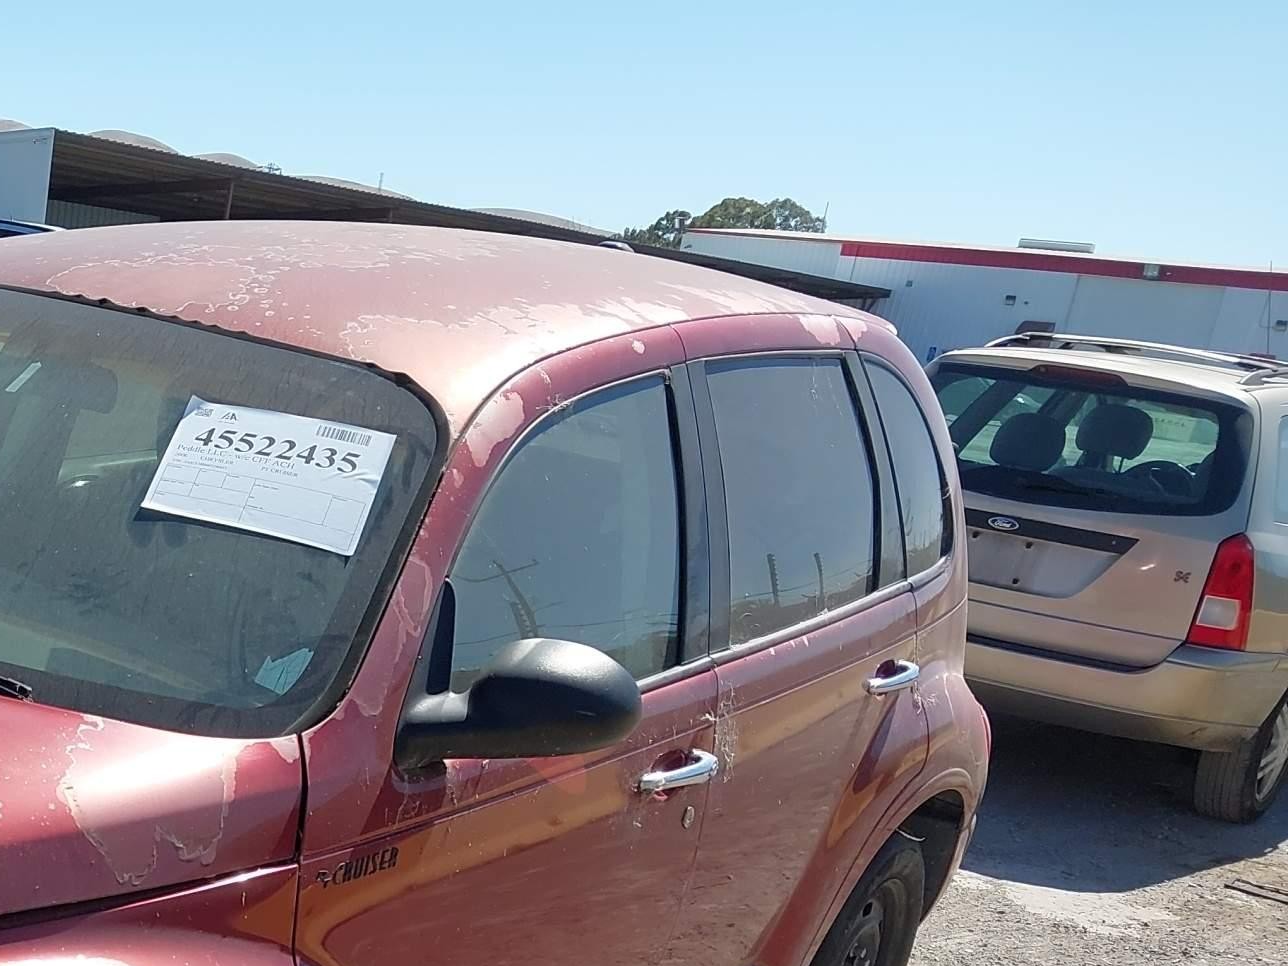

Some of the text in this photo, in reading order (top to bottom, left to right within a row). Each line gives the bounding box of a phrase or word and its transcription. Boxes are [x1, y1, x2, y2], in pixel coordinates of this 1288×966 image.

[194, 427, 361, 473] 45522435
[1173, 570, 1192, 584] SE
[332, 847, 400, 885] CRUISER
